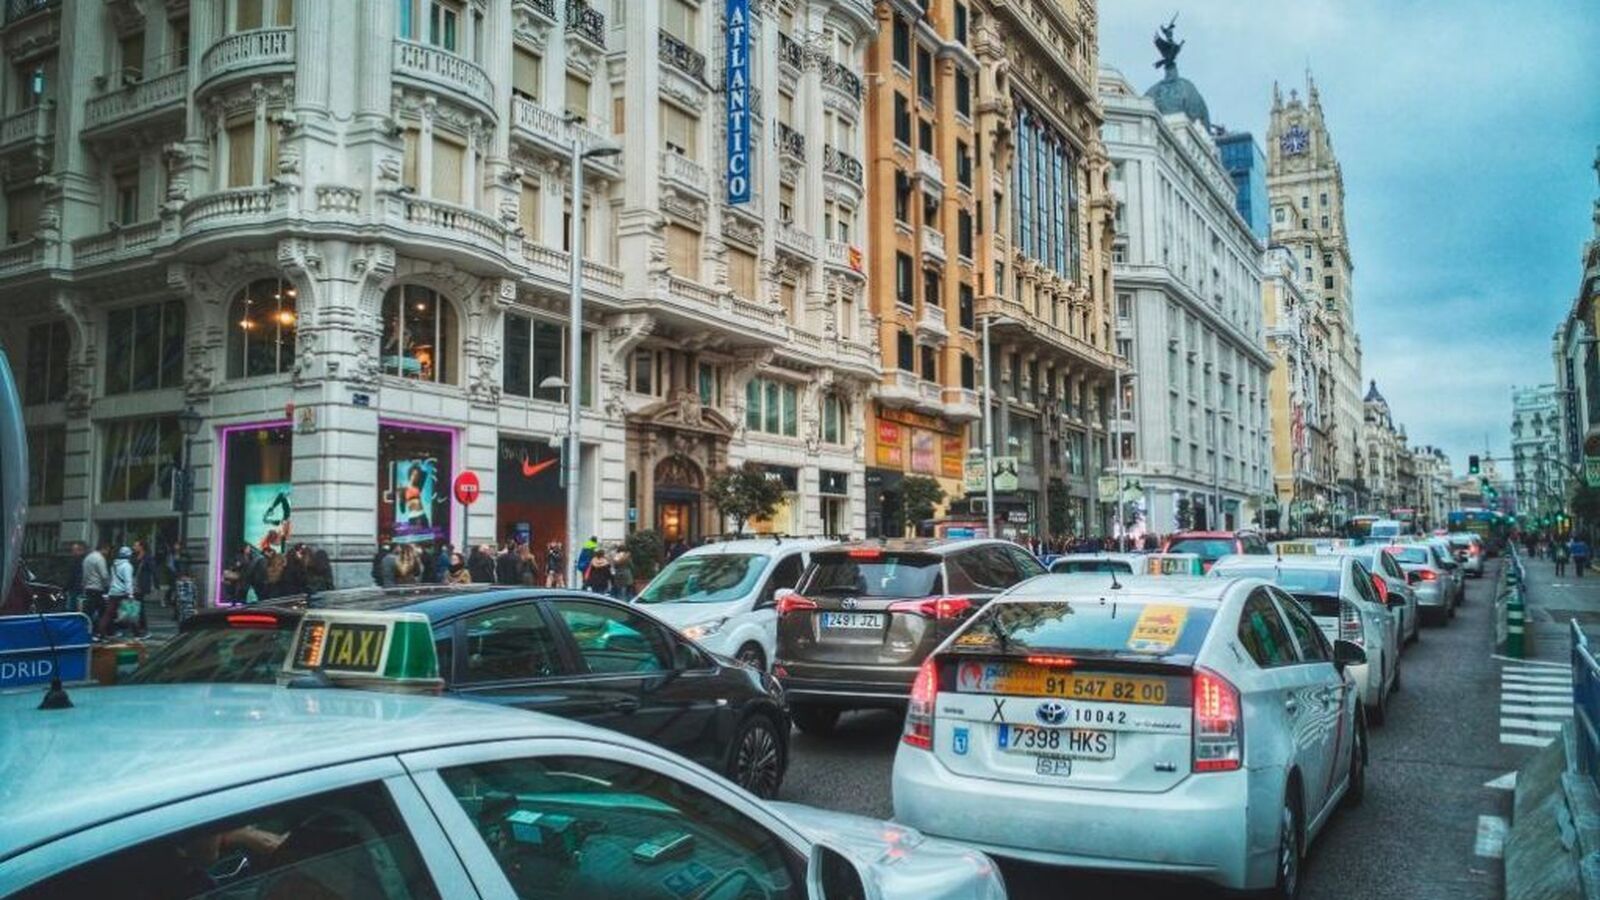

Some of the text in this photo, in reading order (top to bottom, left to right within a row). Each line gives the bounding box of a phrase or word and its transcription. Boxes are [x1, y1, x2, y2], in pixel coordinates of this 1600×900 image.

[729, 6, 746, 197] ATLANTICO
[860, 615, 882, 628] JZL
[328, 628, 384, 666] TAXI
[1, 660, 53, 679] DRID
[1045, 677, 1066, 694] 91
[1073, 680, 1106, 698] 547
[1111, 682, 1136, 699] 82
[1141, 683, 1166, 702] 00
[991, 698, 1006, 722] X
[1074, 708, 1128, 726] 10042
[1011, 727, 1108, 753] 7398 HKS
[1038, 759, 1069, 775] SP
